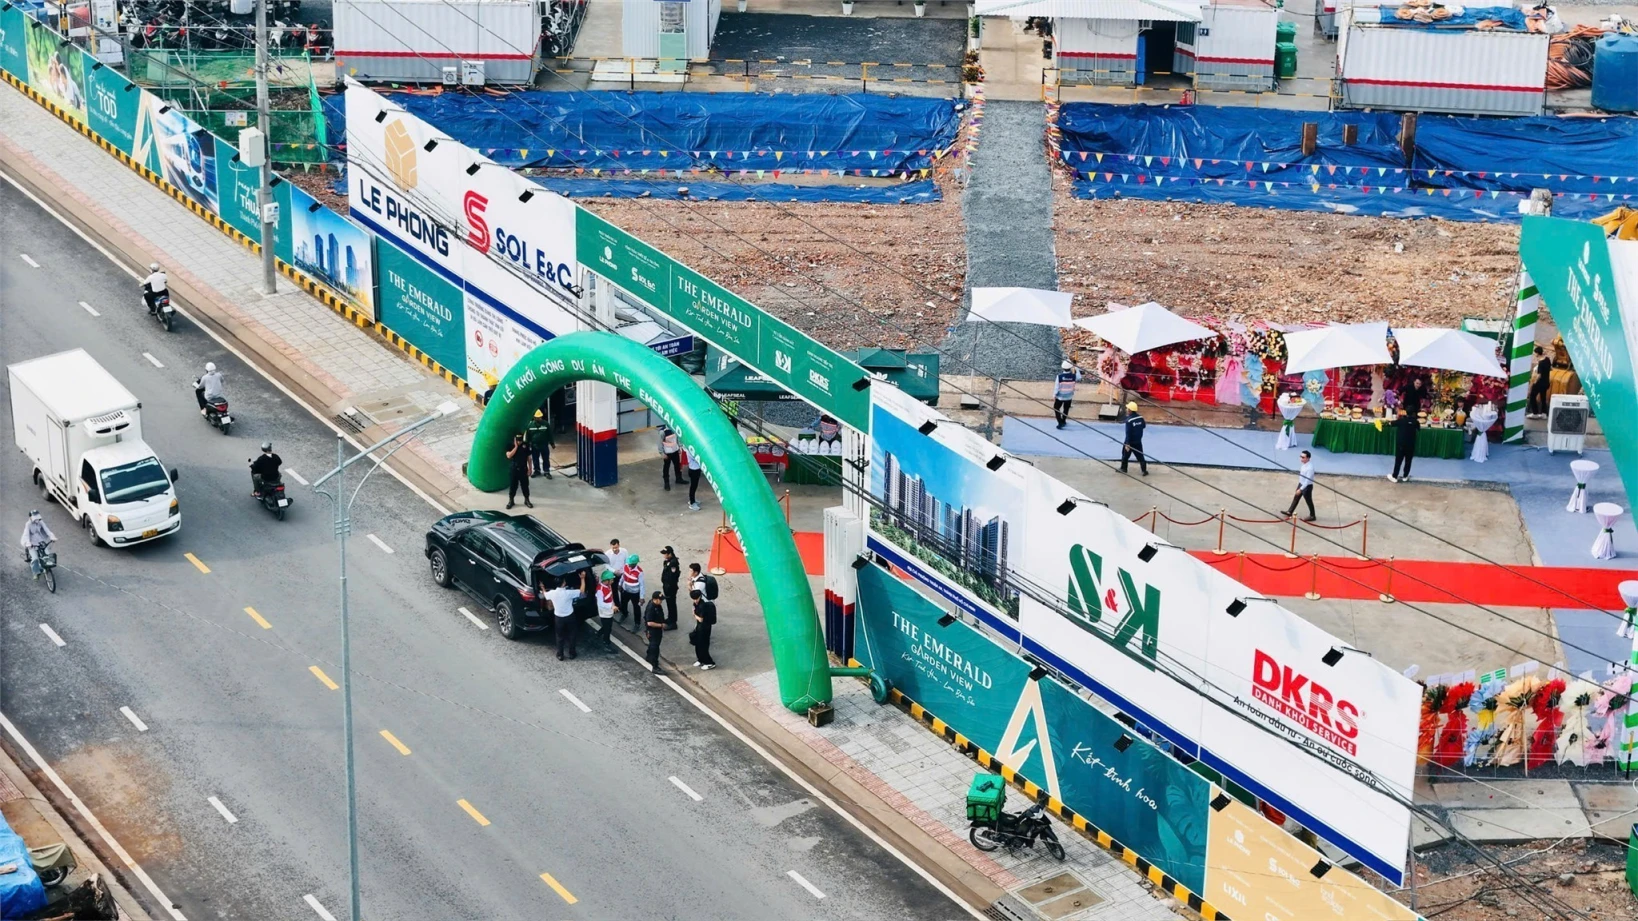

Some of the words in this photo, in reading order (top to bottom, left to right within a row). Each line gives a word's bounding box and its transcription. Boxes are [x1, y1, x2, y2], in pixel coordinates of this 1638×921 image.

[97, 91, 117, 119] TOD
[360, 179, 382, 214] LE
[386, 195, 449, 257] PHONG
[496, 228, 531, 270] SOL
[536, 248, 572, 290] E&C
[388, 270, 406, 292] THE
[409, 284, 452, 322] EMERALD
[402, 294, 425, 315] GARDEN
[426, 311, 440, 325] VIEW
[678, 276, 698, 298] THE
[702, 290, 752, 328] EMERALD
[692, 300, 719, 321] GARDEN
[720, 317, 738, 332] VIEW
[1568, 266, 1581, 311] THE
[1581, 296, 1612, 380] EMERALD
[810, 368, 830, 386] DKRS
[502, 384, 514, 404] LỄ
[515, 366, 536, 390] KHỞI
[540, 358, 564, 374] CÔNG
[571, 360, 585, 373] DỰ
[592, 360, 606, 376] ÁN
[612, 372, 631, 390] THE
[640, 388, 682, 438] EMERALD
[688, 445, 724, 504] GARDEN
[730, 513, 749, 557] VIEW
[1068, 544, 1161, 672] S&K
[892, 611, 919, 641] THE
[924, 632, 992, 690] EMERALD
[911, 644, 948, 674] GARDEN
[950, 670, 973, 692] VIEW
[1253, 648, 1359, 739] DKRS
[1255, 688, 1282, 712] DANH
[1286, 704, 1310, 728] KHÔI
[1312, 724, 1353, 754] SERVICE
[1303, 737, 1314, 750] An
[1135, 788, 1158, 810] hoa
[1223, 882, 1246, 906] LIXIL
